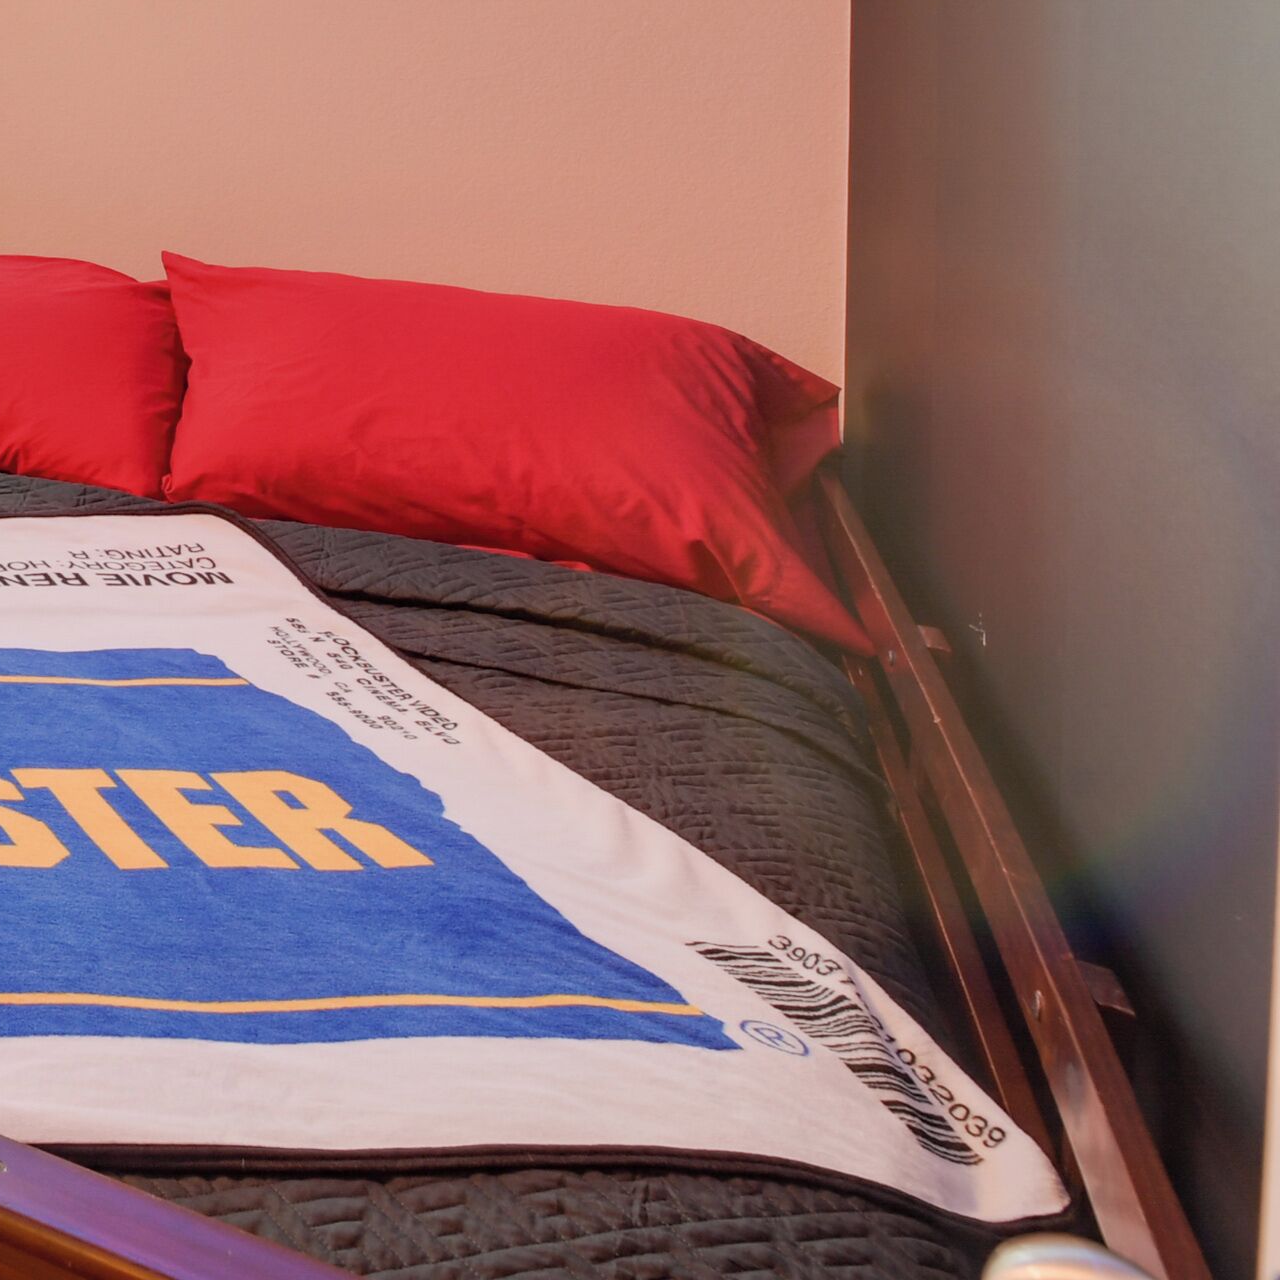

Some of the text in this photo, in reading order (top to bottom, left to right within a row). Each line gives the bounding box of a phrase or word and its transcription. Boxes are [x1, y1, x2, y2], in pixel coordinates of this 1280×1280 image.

[67, 549, 87, 561] R
[96, 542, 206, 561] RATING:
[59, 555, 218, 571] CATEGORY:
[102, 570, 236, 586] MOVIE
[266, 638, 310, 670] STORE
[408, 698, 459, 732] VIDEO
